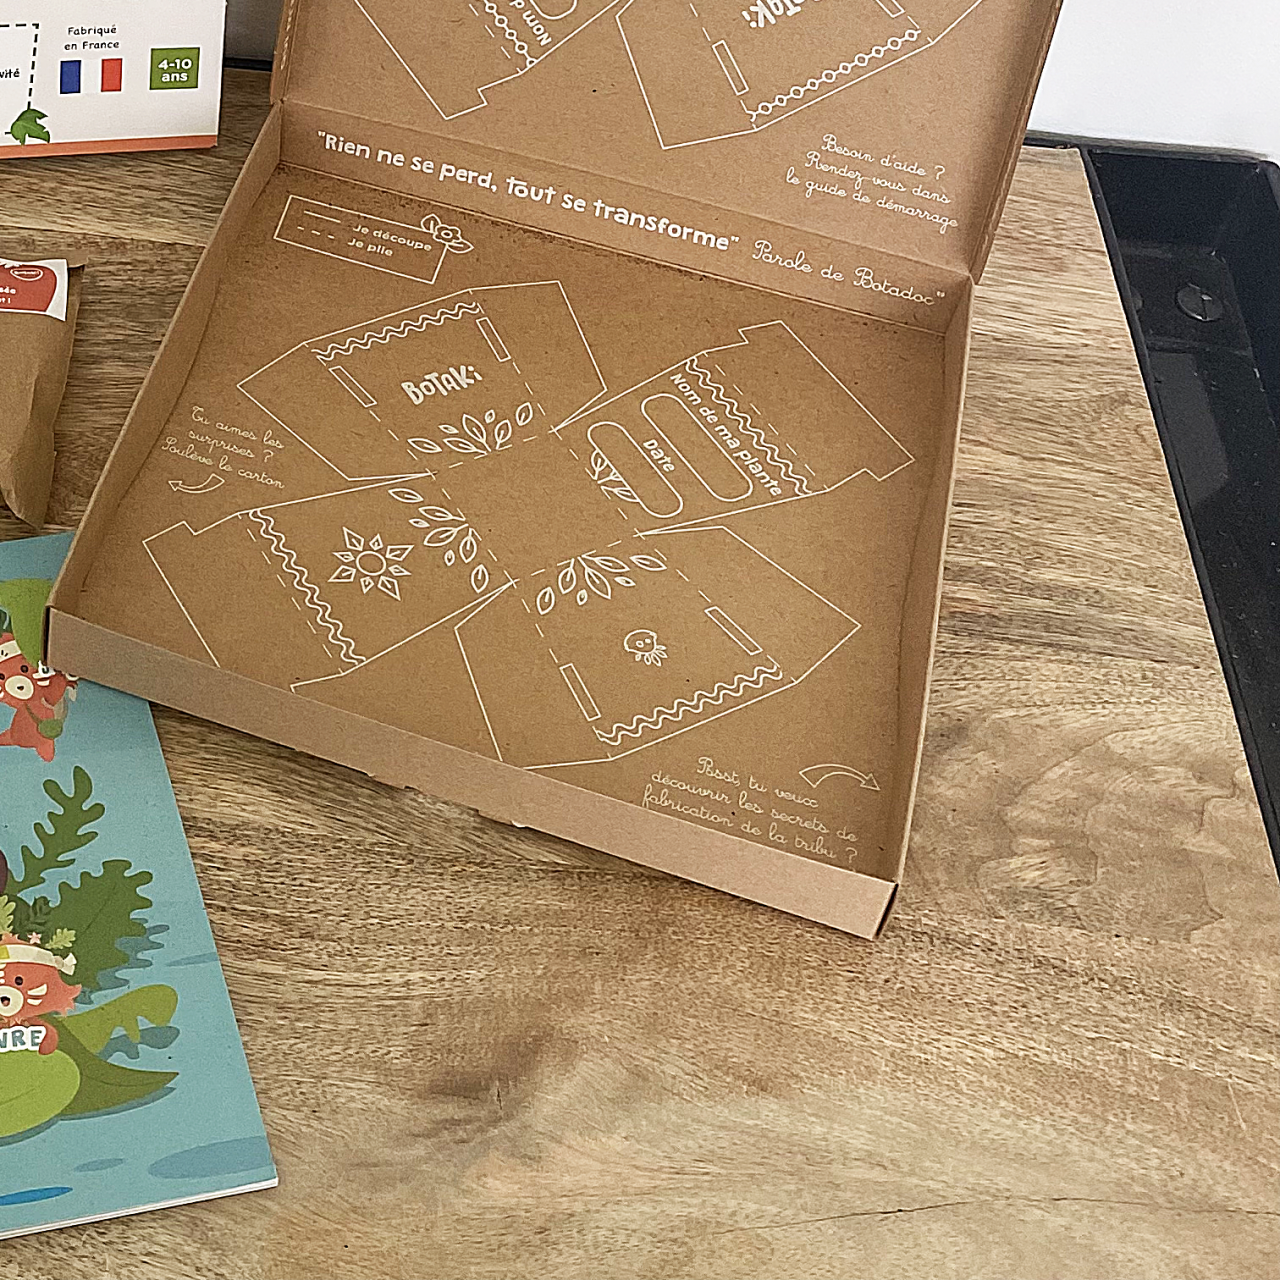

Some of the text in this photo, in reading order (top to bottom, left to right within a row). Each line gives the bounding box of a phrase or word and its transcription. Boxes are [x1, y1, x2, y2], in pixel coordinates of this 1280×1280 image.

[64, 41, 120, 51] en France
[68, 24, 117, 37] Fabriqué
[523, 13, 552, 47] Nom
[158, 58, 192, 70] 4-10
[161, 72, 188, 82] ans
[821, 133, 946, 180] Besoin d'aide ?
[786, 166, 959, 234] le guide de démarrage
[912, 184, 951, 204] dans
[377, 148, 405, 168] ne
[410, 156, 434, 174] se
[439, 163, 497, 193] perd,
[561, 192, 587, 214] se
[752, 239, 814, 274] Parole
[821, 264, 845, 282] de
[348, 237, 393, 258] Je plie
[353, 224, 432, 252] Je découpe
[188, 430, 274, 463] surprises ?
[216, 422, 257, 440] aimes
[263, 429, 284, 449] les
[669, 372, 783, 497] Nom de ma plante
[218, 455, 233, 472] le
[238, 469, 285, 489] carton
[642, 438, 676, 473] Date
[652, 770, 859, 842] découvrir les secrets de
[748, 775, 768, 793] tu
[774, 788, 819, 808] veux
[642, 784, 734, 827] fabrication
[741, 820, 762, 836] de
[769, 822, 788, 845] la
[845, 847, 857, 863] ?
